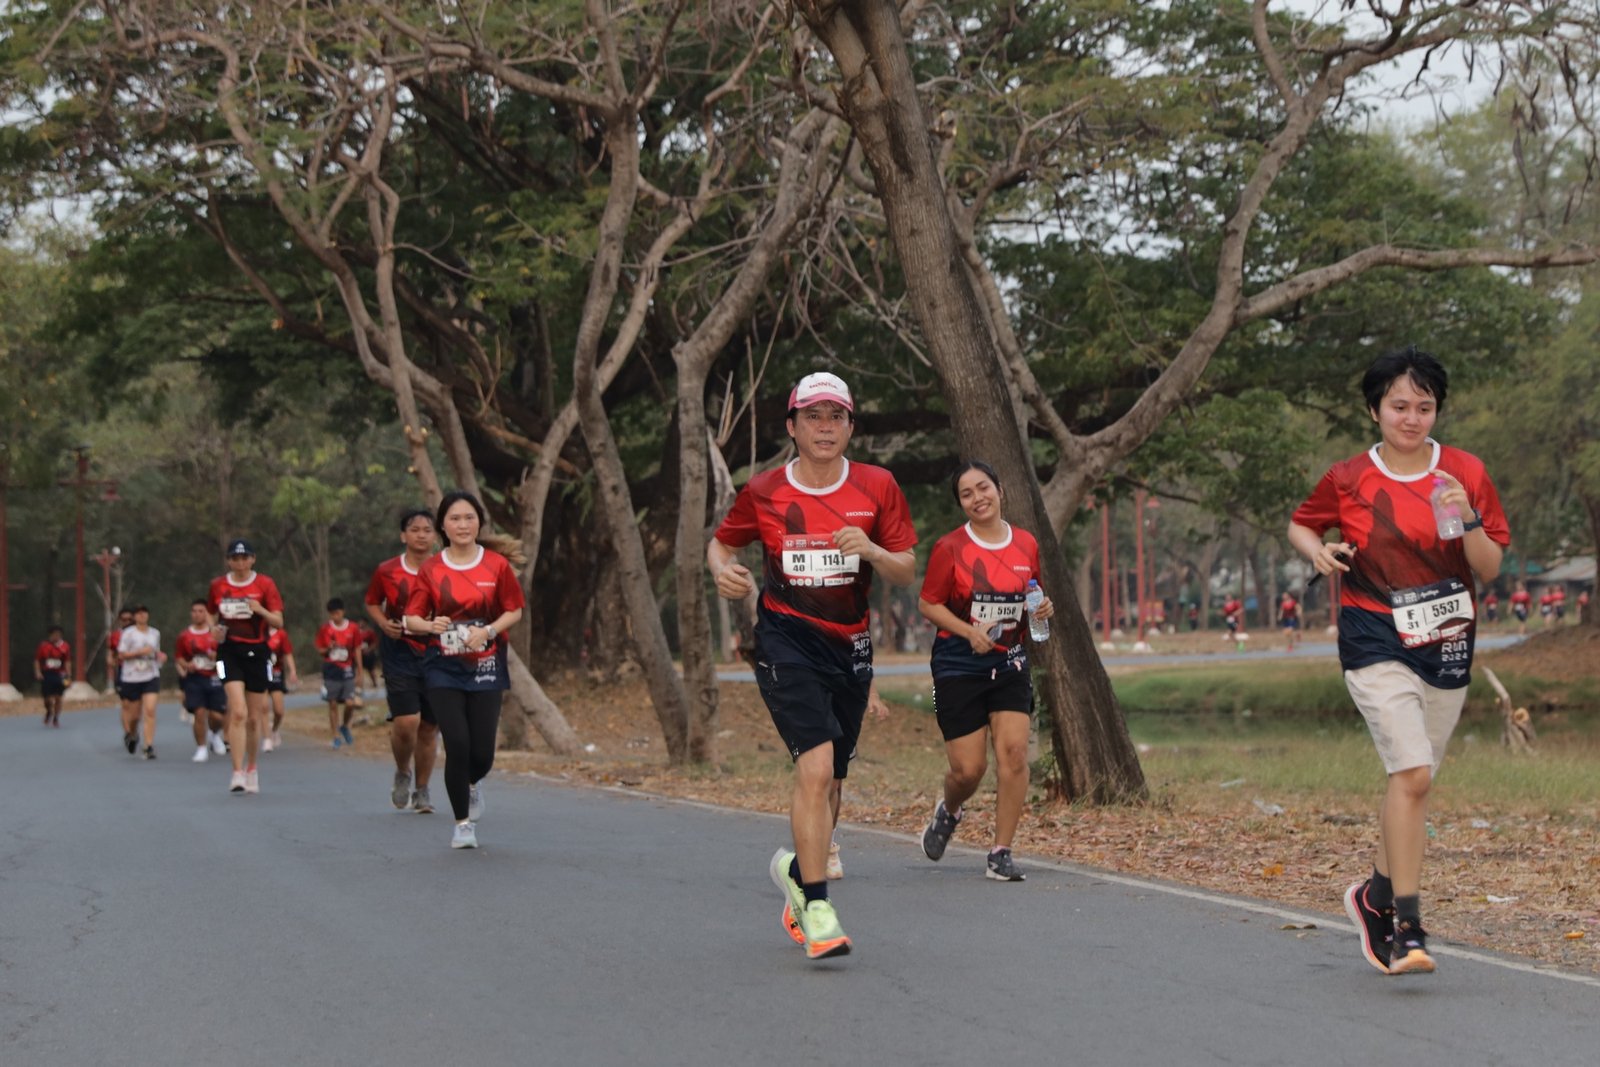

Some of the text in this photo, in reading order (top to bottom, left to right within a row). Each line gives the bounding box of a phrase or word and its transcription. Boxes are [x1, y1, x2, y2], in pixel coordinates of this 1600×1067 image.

[792, 554, 806, 563] M
[822, 554, 846, 566] 1141
[1407, 609, 1414, 620] F
[1431, 600, 1461, 618] 5537
[1407, 621, 1420, 630] 31
